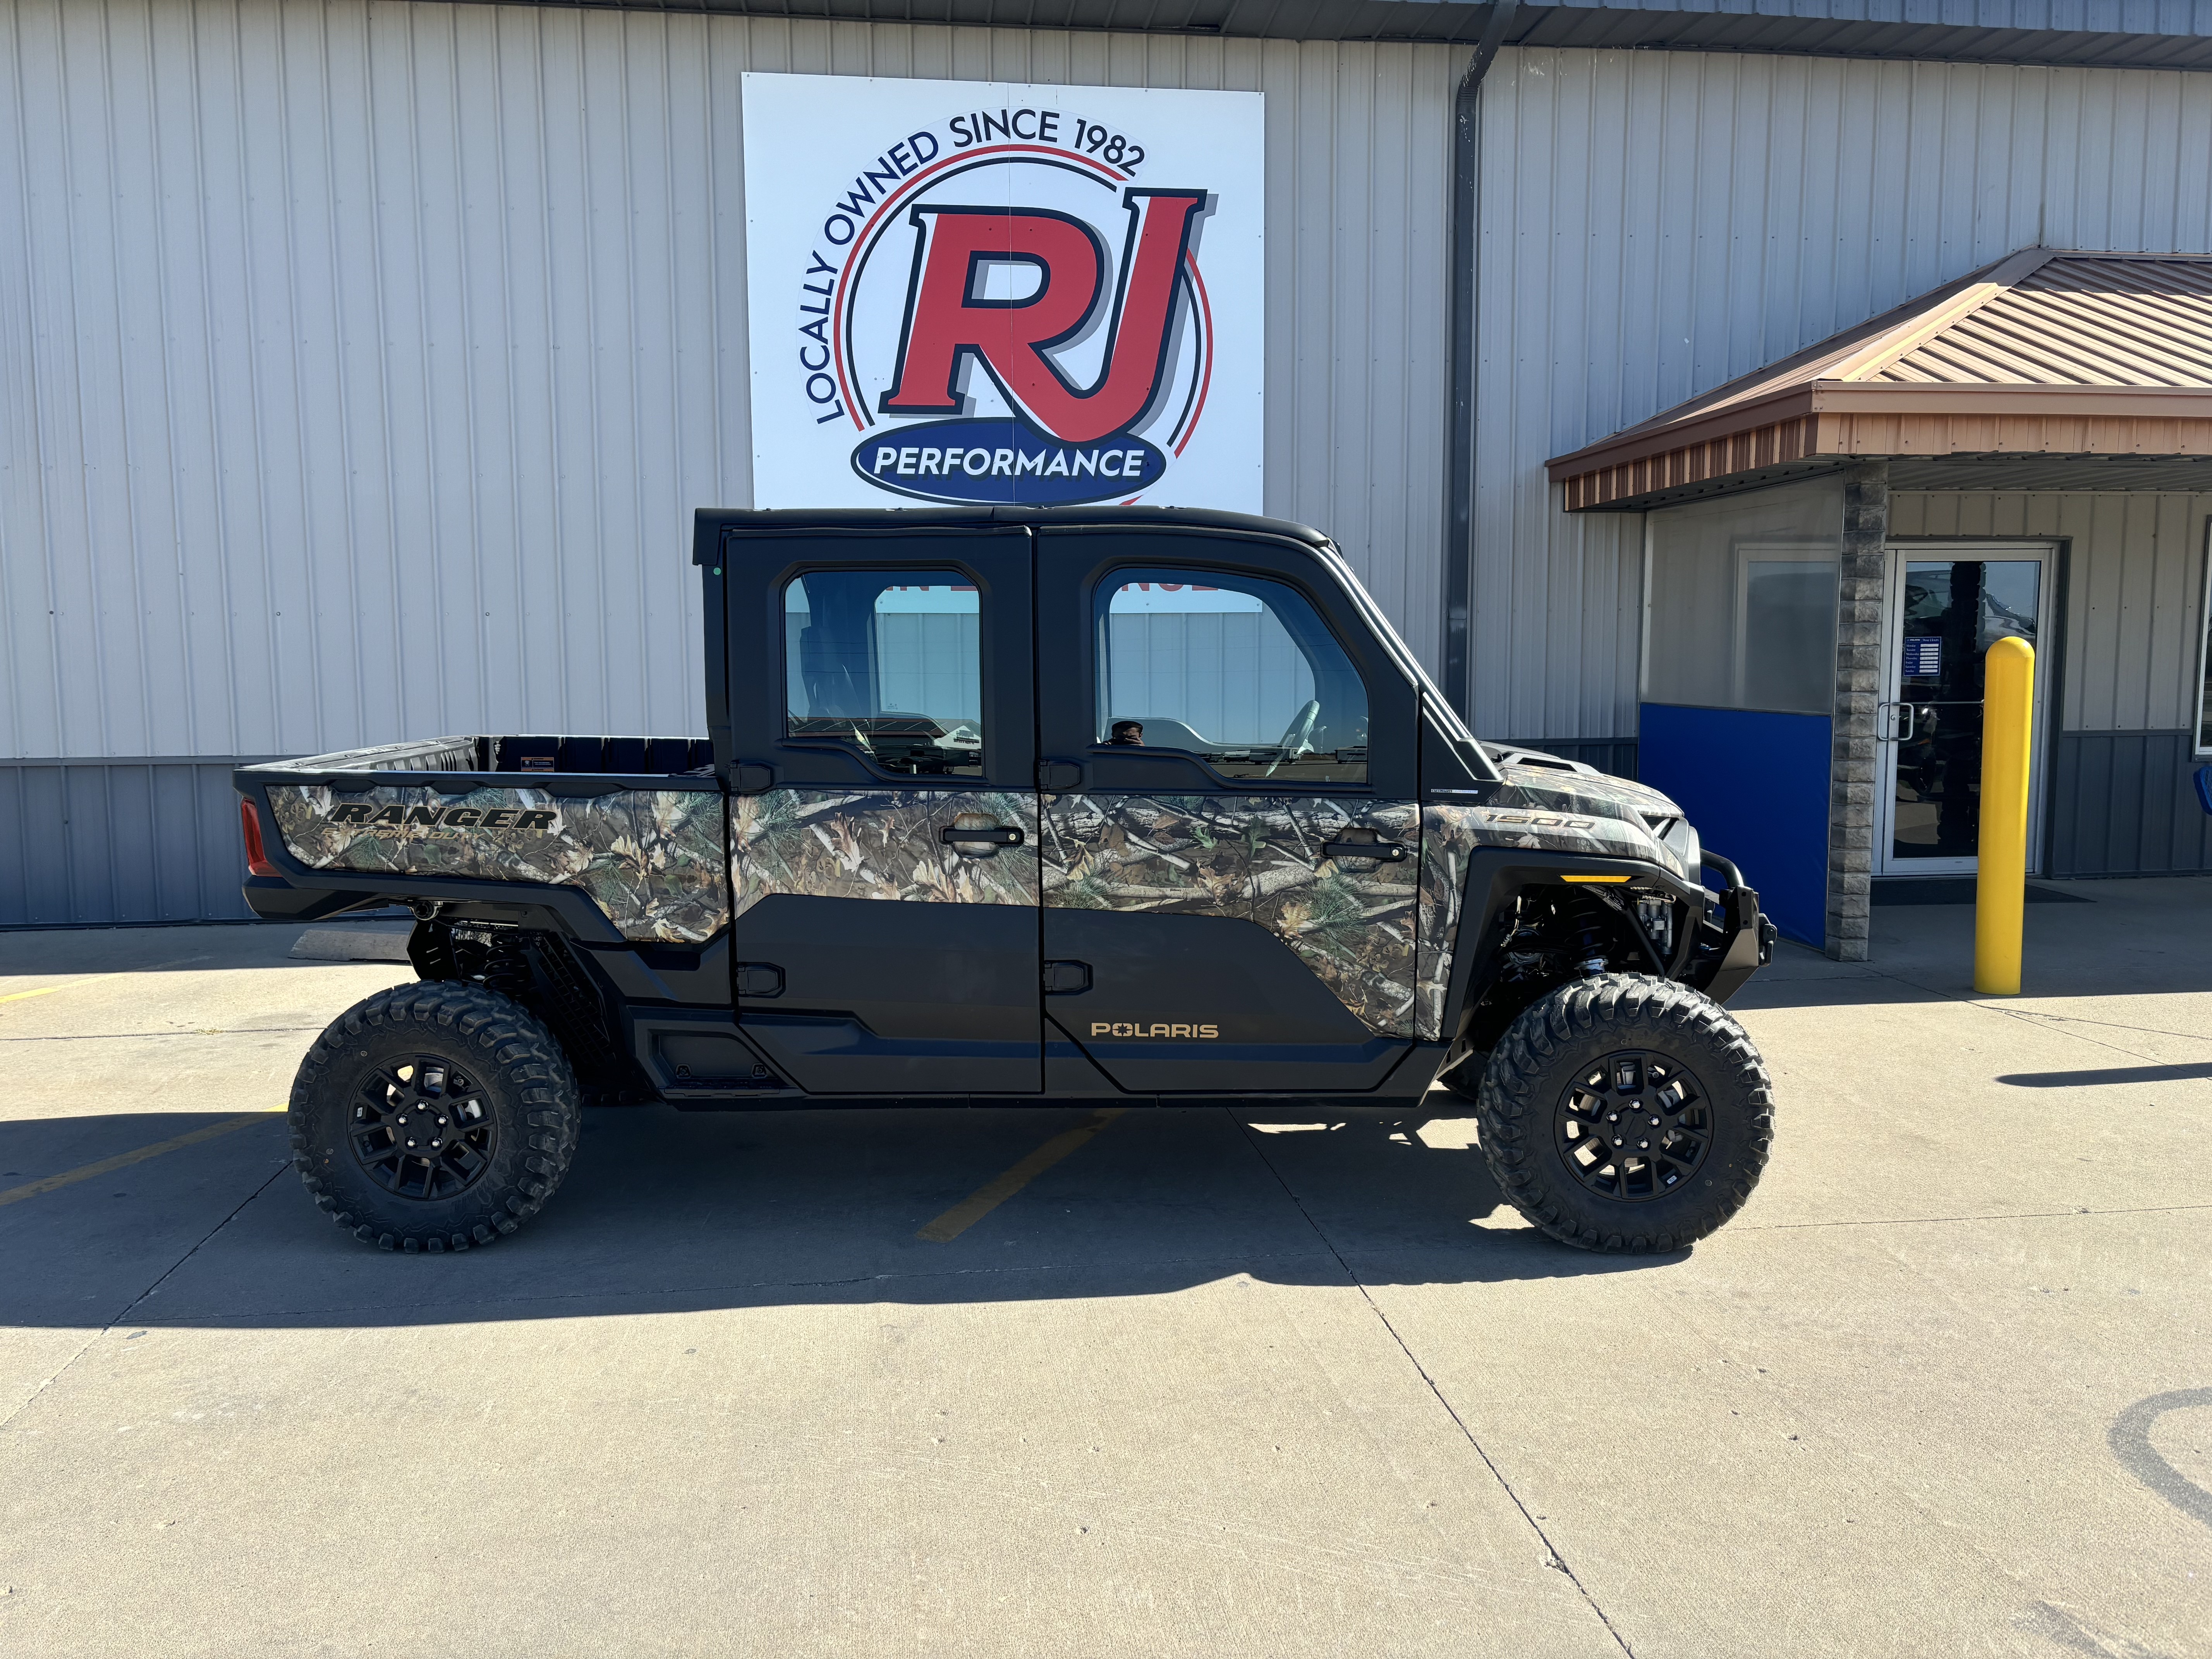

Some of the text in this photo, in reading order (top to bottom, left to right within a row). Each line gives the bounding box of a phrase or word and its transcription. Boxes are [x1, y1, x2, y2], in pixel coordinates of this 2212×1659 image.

[798, 109, 1145, 424] LOCALLY OWNED SINCE 1982
[878, 187, 1208, 448] RJ
[874, 446, 1144, 477] PERFORMANCE
[329, 803, 557, 830] RANGER
[1484, 814, 1597, 830] 1500
[321, 828, 485, 840] EXTREME DUTY
[1091, 1022, 1219, 1038] POLARIS
